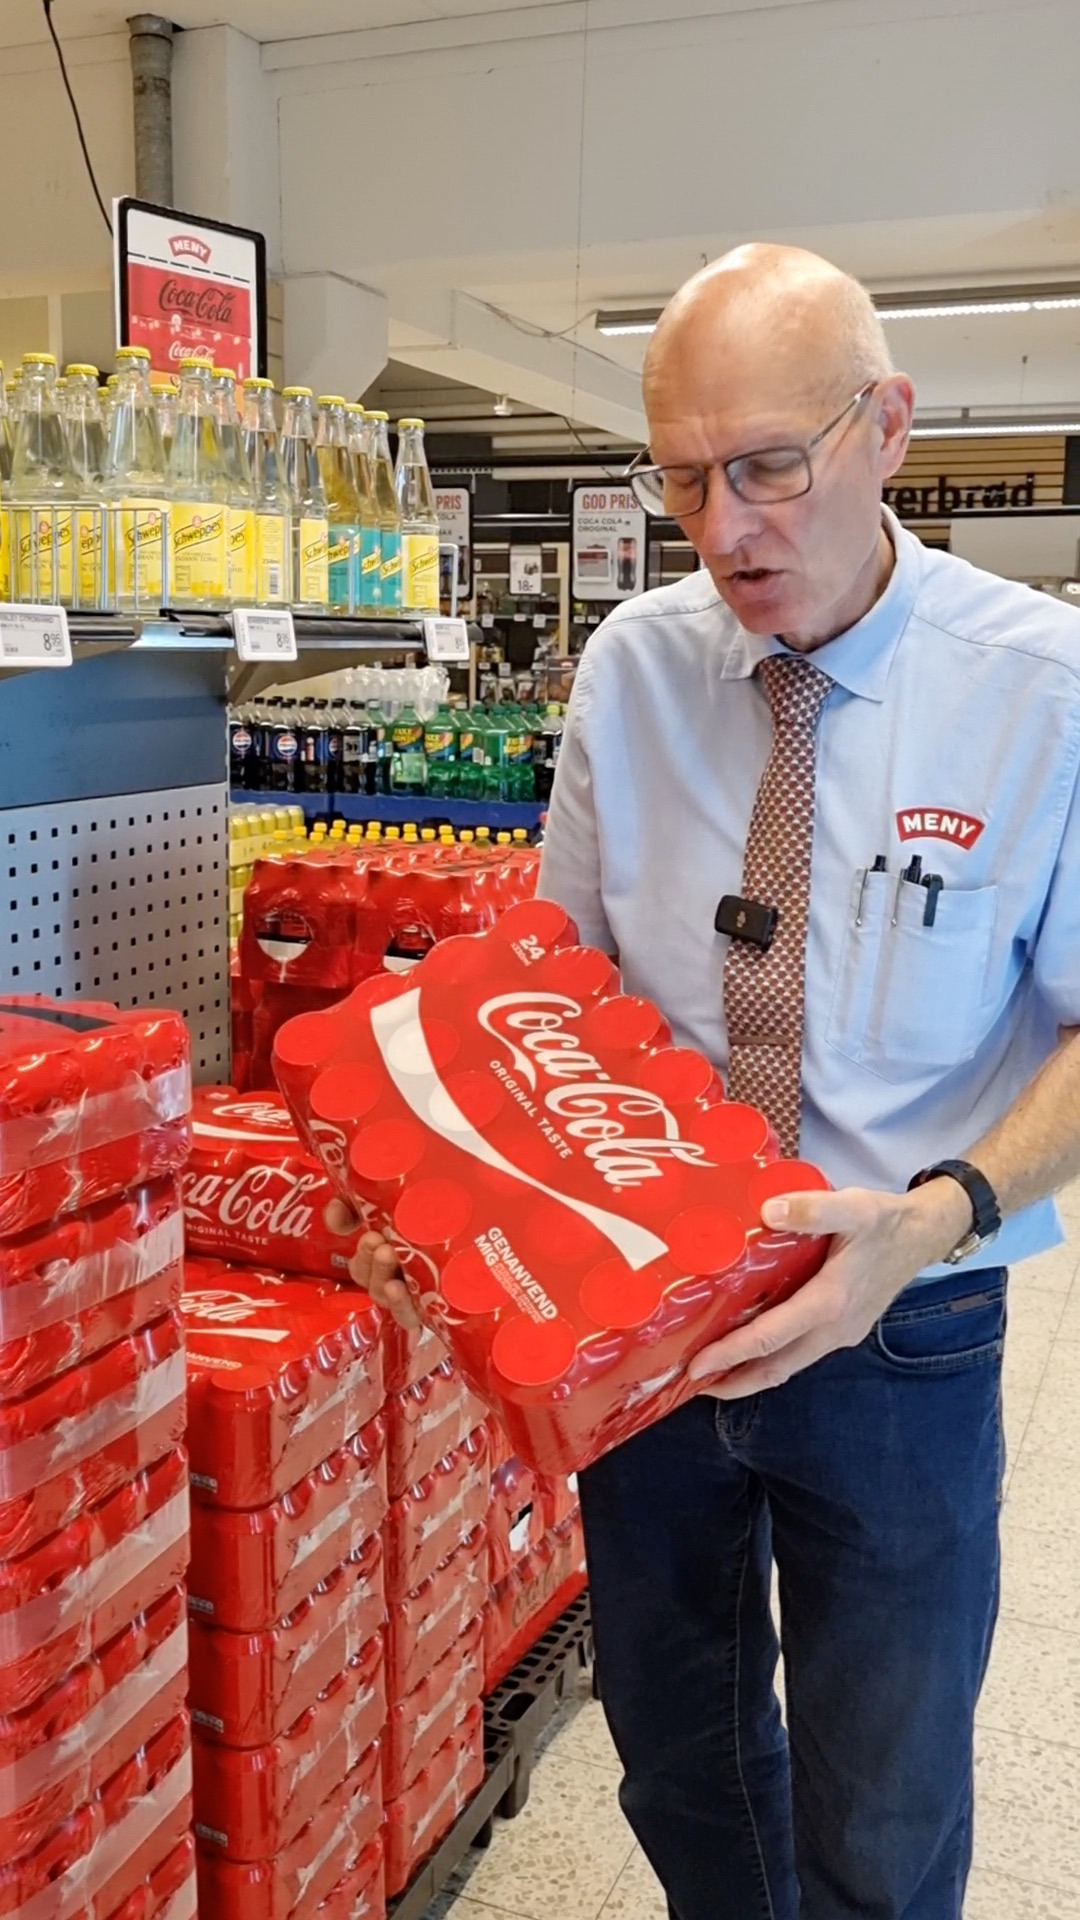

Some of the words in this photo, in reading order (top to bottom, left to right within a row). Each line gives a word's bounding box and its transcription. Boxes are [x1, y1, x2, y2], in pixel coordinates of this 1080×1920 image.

[173, 240, 208, 256] MENY
[436, 495, 462, 510] PRIS
[582, 494, 606, 510] GOD
[610, 494, 638, 510] PRIS
[173, 519, 221, 549] Schweppes
[578, 517, 599, 525] COCA
[601, 517, 623, 525] COLA
[902, 813, 977, 840] MENY
[519, 934, 546, 960] 24
[489, 1060, 537, 1118] ORIGINAL
[537, 1117, 574, 1159] TASTE
[235, 1230, 269, 1246] TASTE
[474, 1233, 500, 1267] MIG
[488, 1227, 558, 1320] GENANVEND
